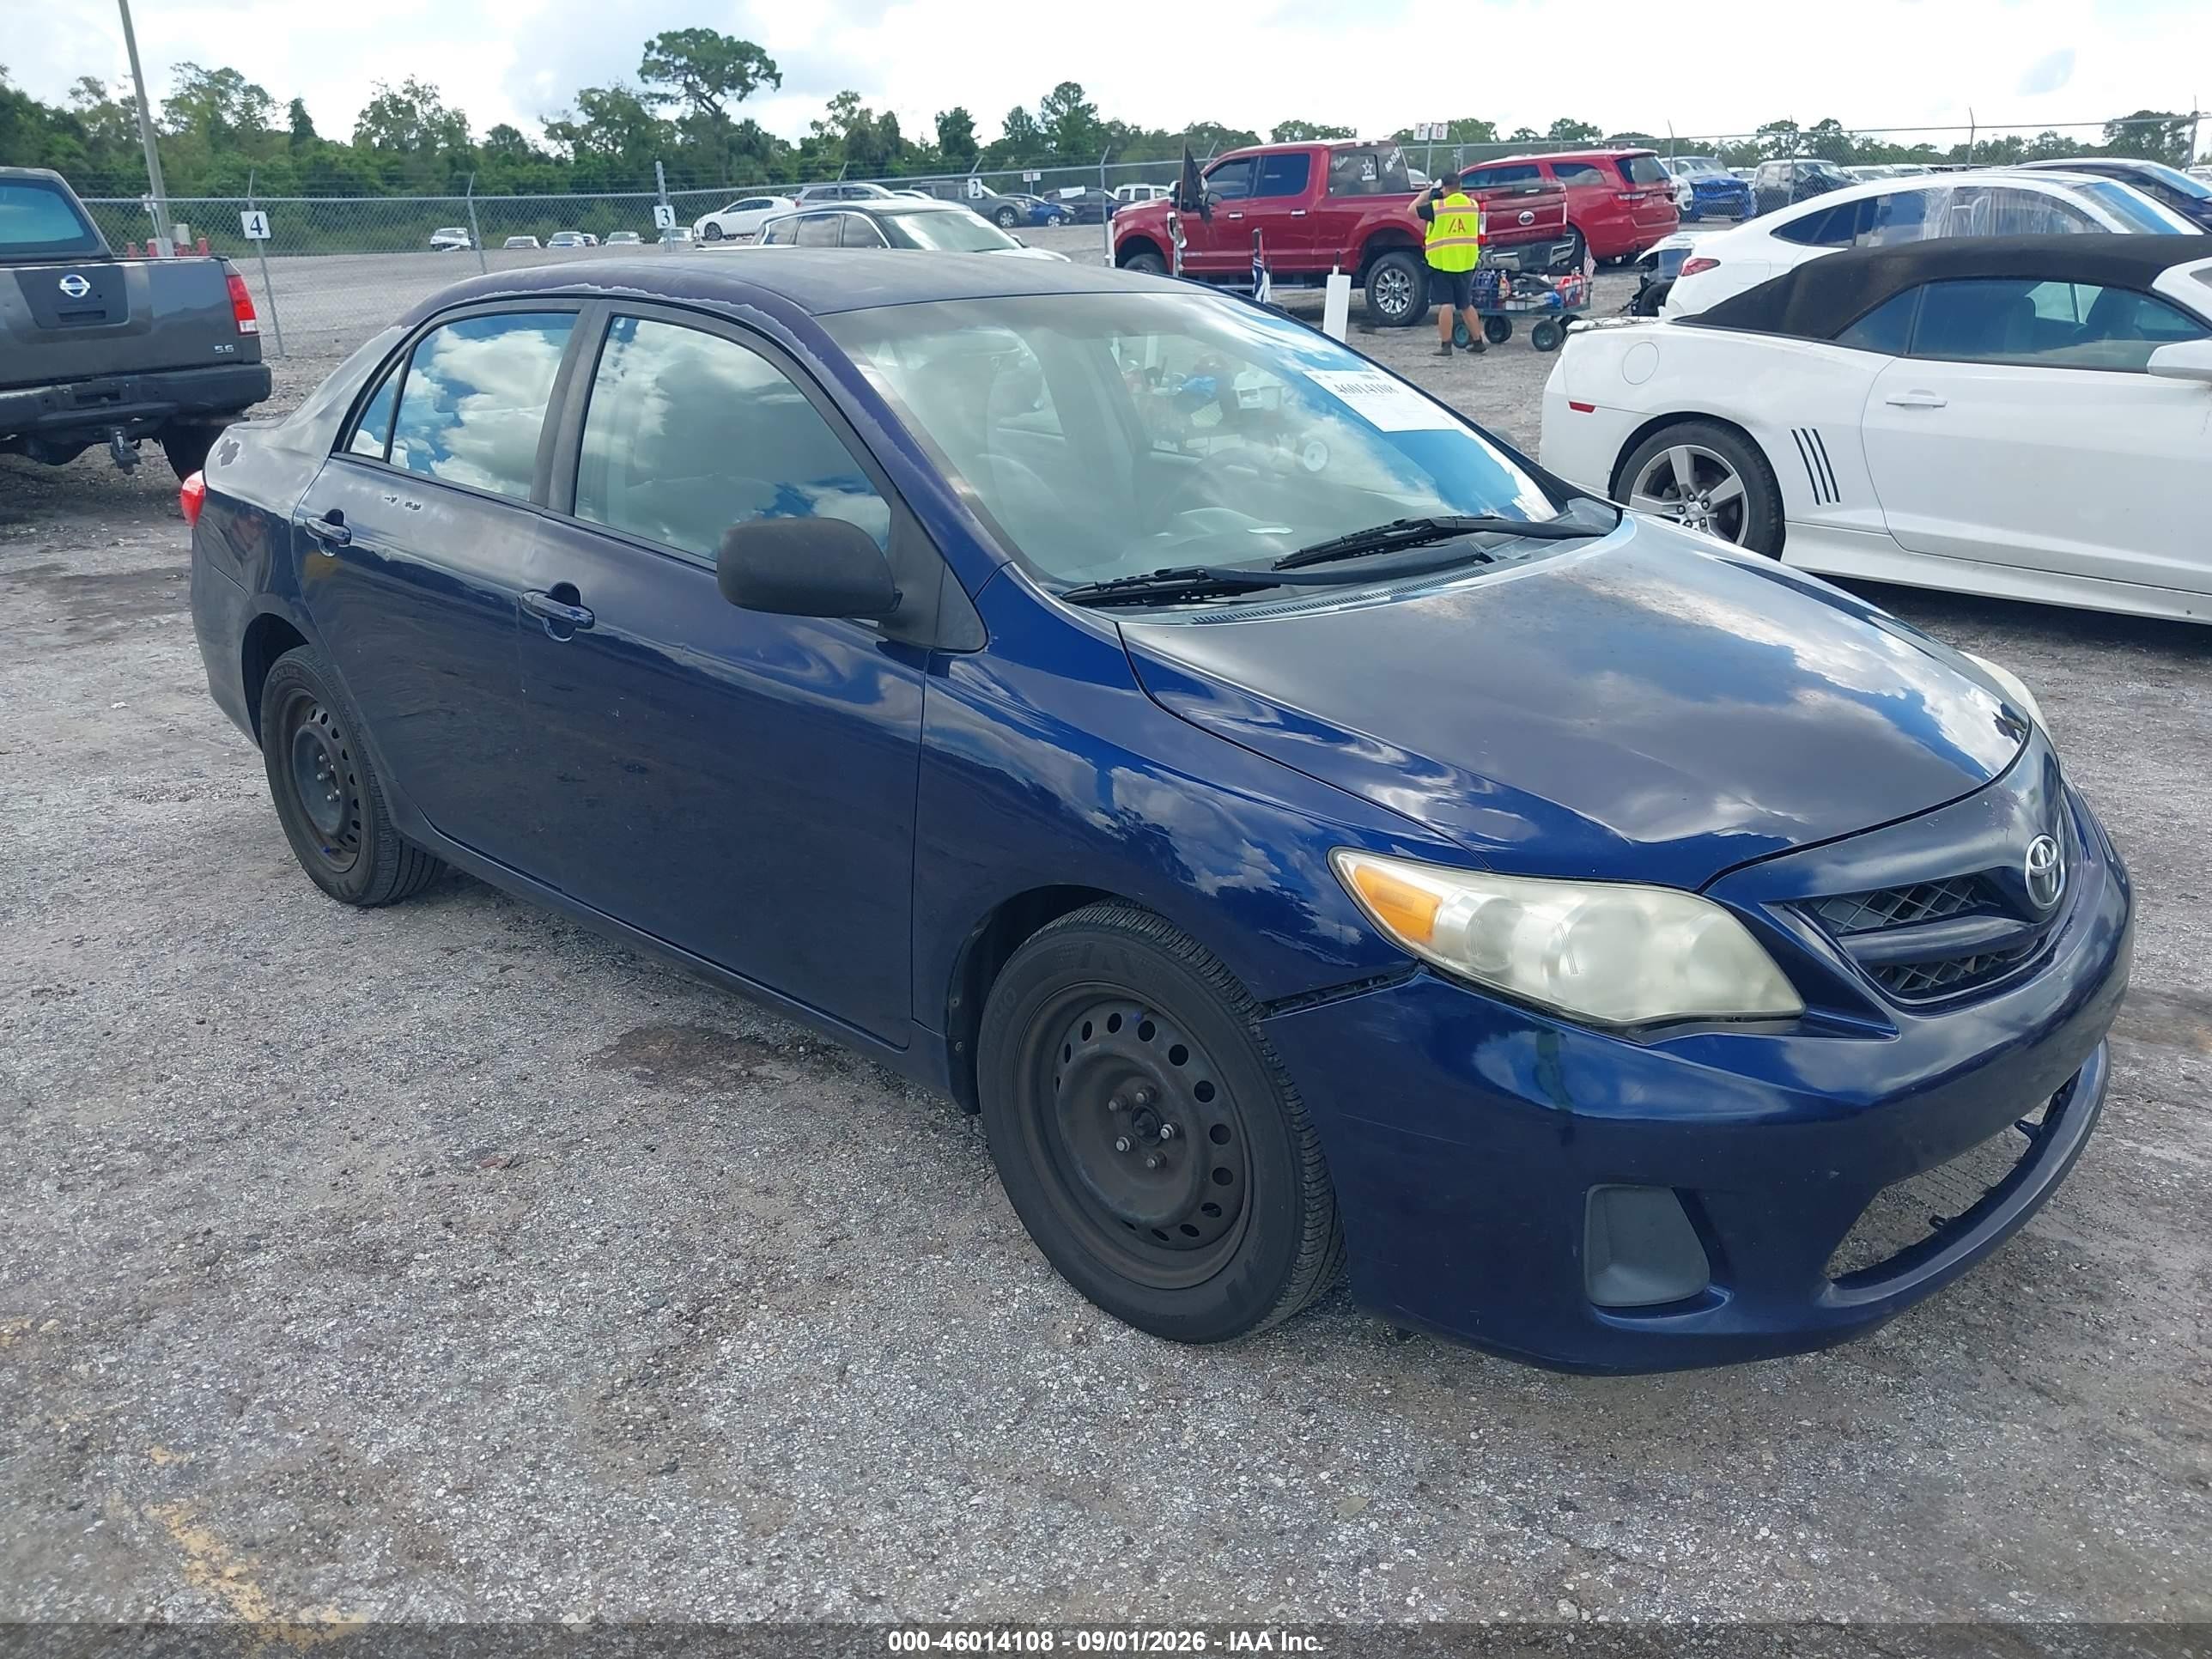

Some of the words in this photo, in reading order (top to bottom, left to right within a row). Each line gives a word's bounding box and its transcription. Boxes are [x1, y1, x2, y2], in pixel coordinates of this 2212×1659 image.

[1418, 124, 1425, 138] F
[1436, 124, 1443, 138] G
[971, 180, 979, 197] 2
[250, 214, 263, 236] 4
[660, 208, 671, 227] 3
